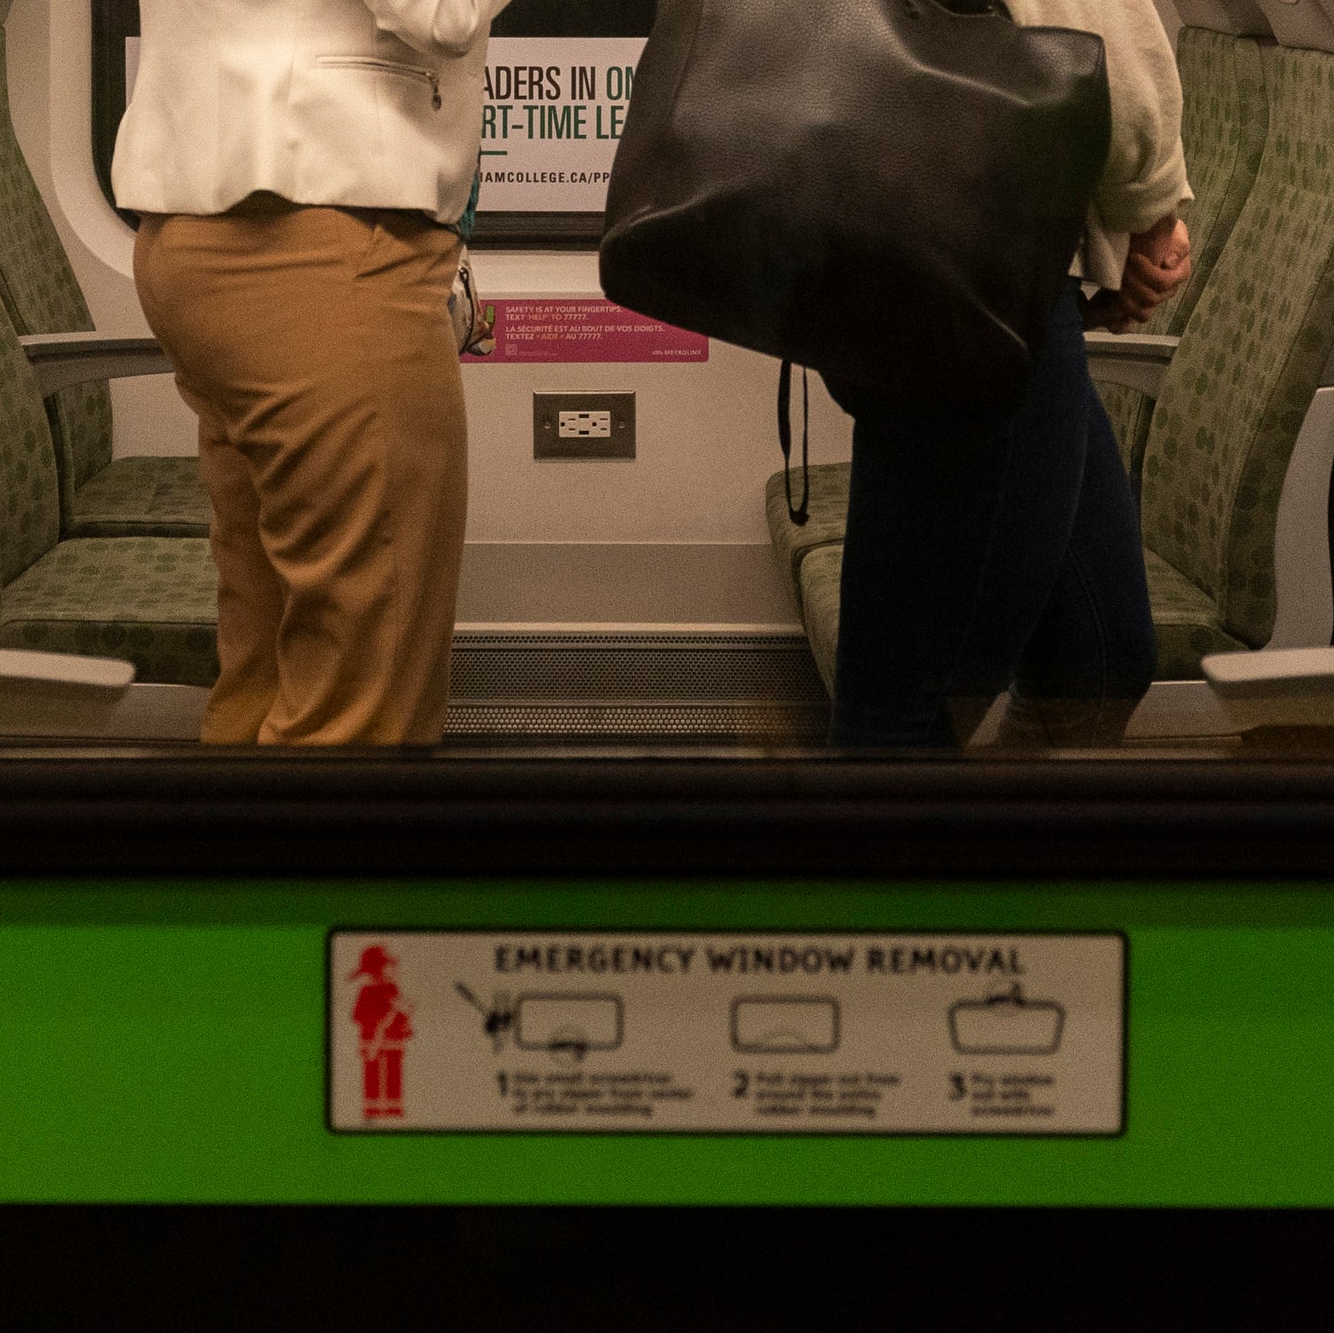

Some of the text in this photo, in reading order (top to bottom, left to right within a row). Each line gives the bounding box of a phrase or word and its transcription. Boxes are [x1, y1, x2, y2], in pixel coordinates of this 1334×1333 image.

[483, 66, 635, 100] ADERS IN ON
[481, 105, 624, 139] RT-TIME LE
[479, 172, 610, 184] AMCOLLEGE.CA/PP
[517, 324, 553, 333] SÉCURITÉ
[494, 947, 1025, 973] EMERGENCY WINDOW REMOVAL
[497, 1071, 508, 1098] 1
[733, 1072, 750, 1099] 2
[949, 1072, 966, 1100] 3
